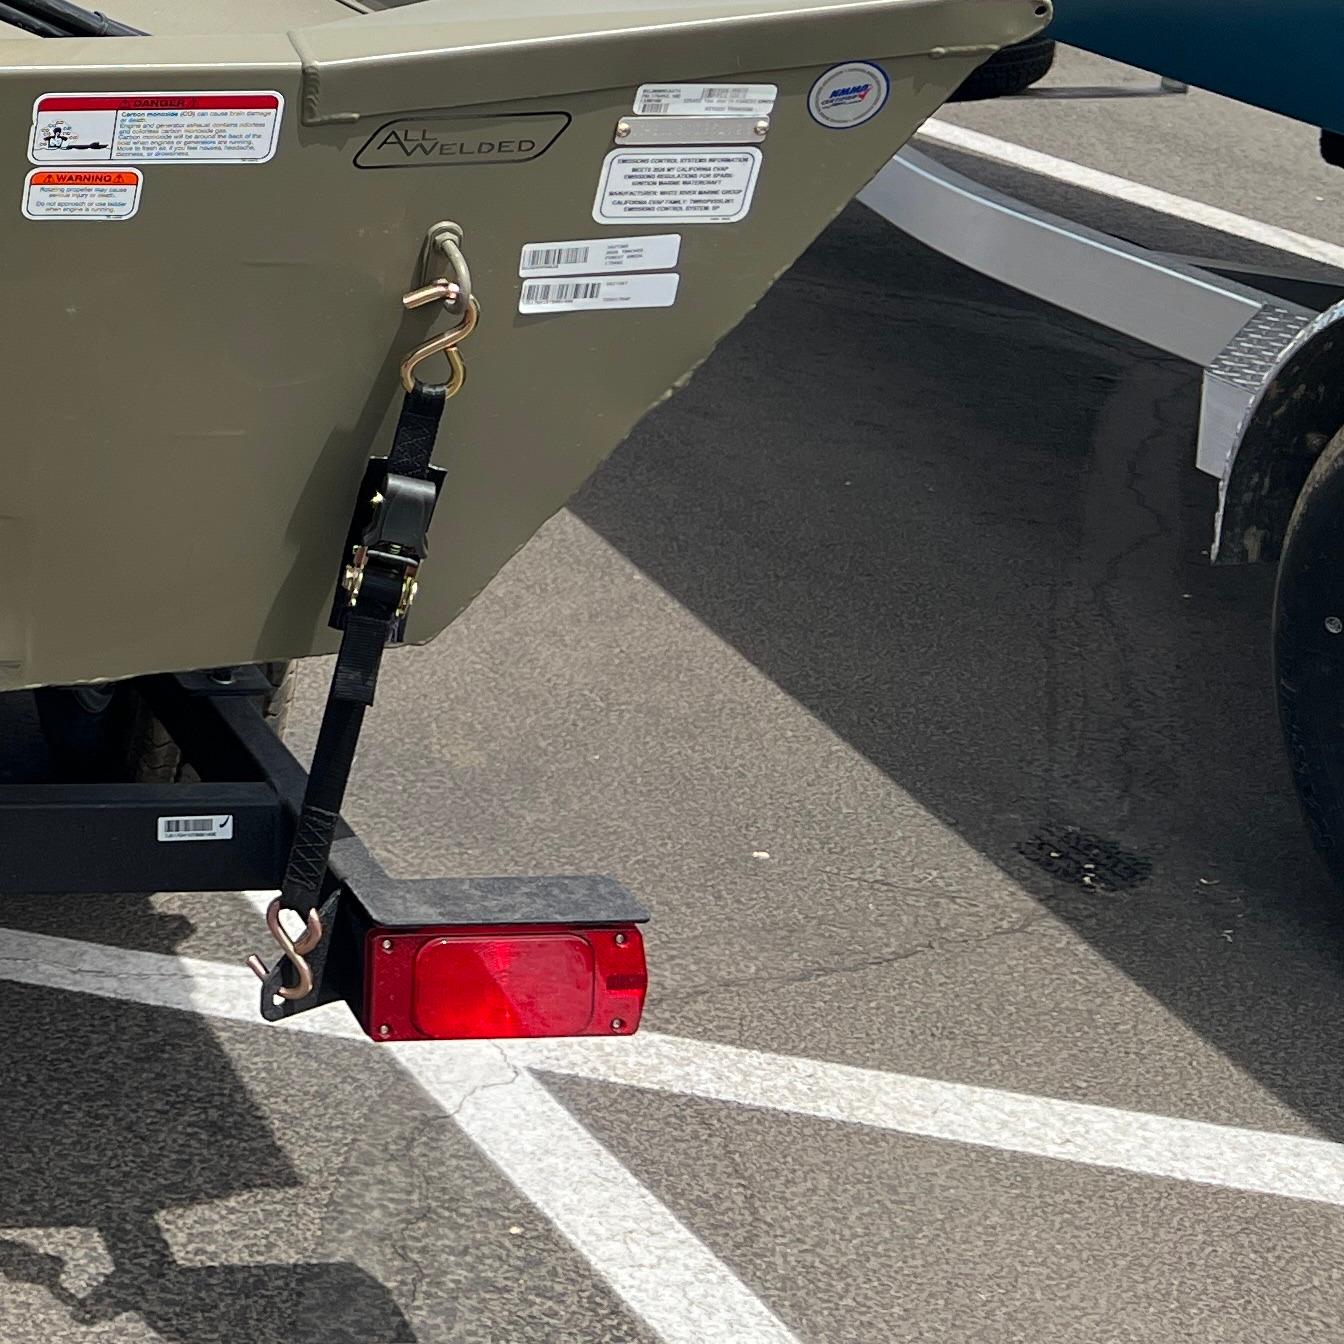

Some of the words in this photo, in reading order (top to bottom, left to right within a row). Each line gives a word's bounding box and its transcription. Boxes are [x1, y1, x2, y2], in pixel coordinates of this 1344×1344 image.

[134, 99, 185, 107] DANGER
[377, 129, 437, 150] ALL
[403, 139, 535, 156] WELDED
[56, 174, 112, 182] WARNING
